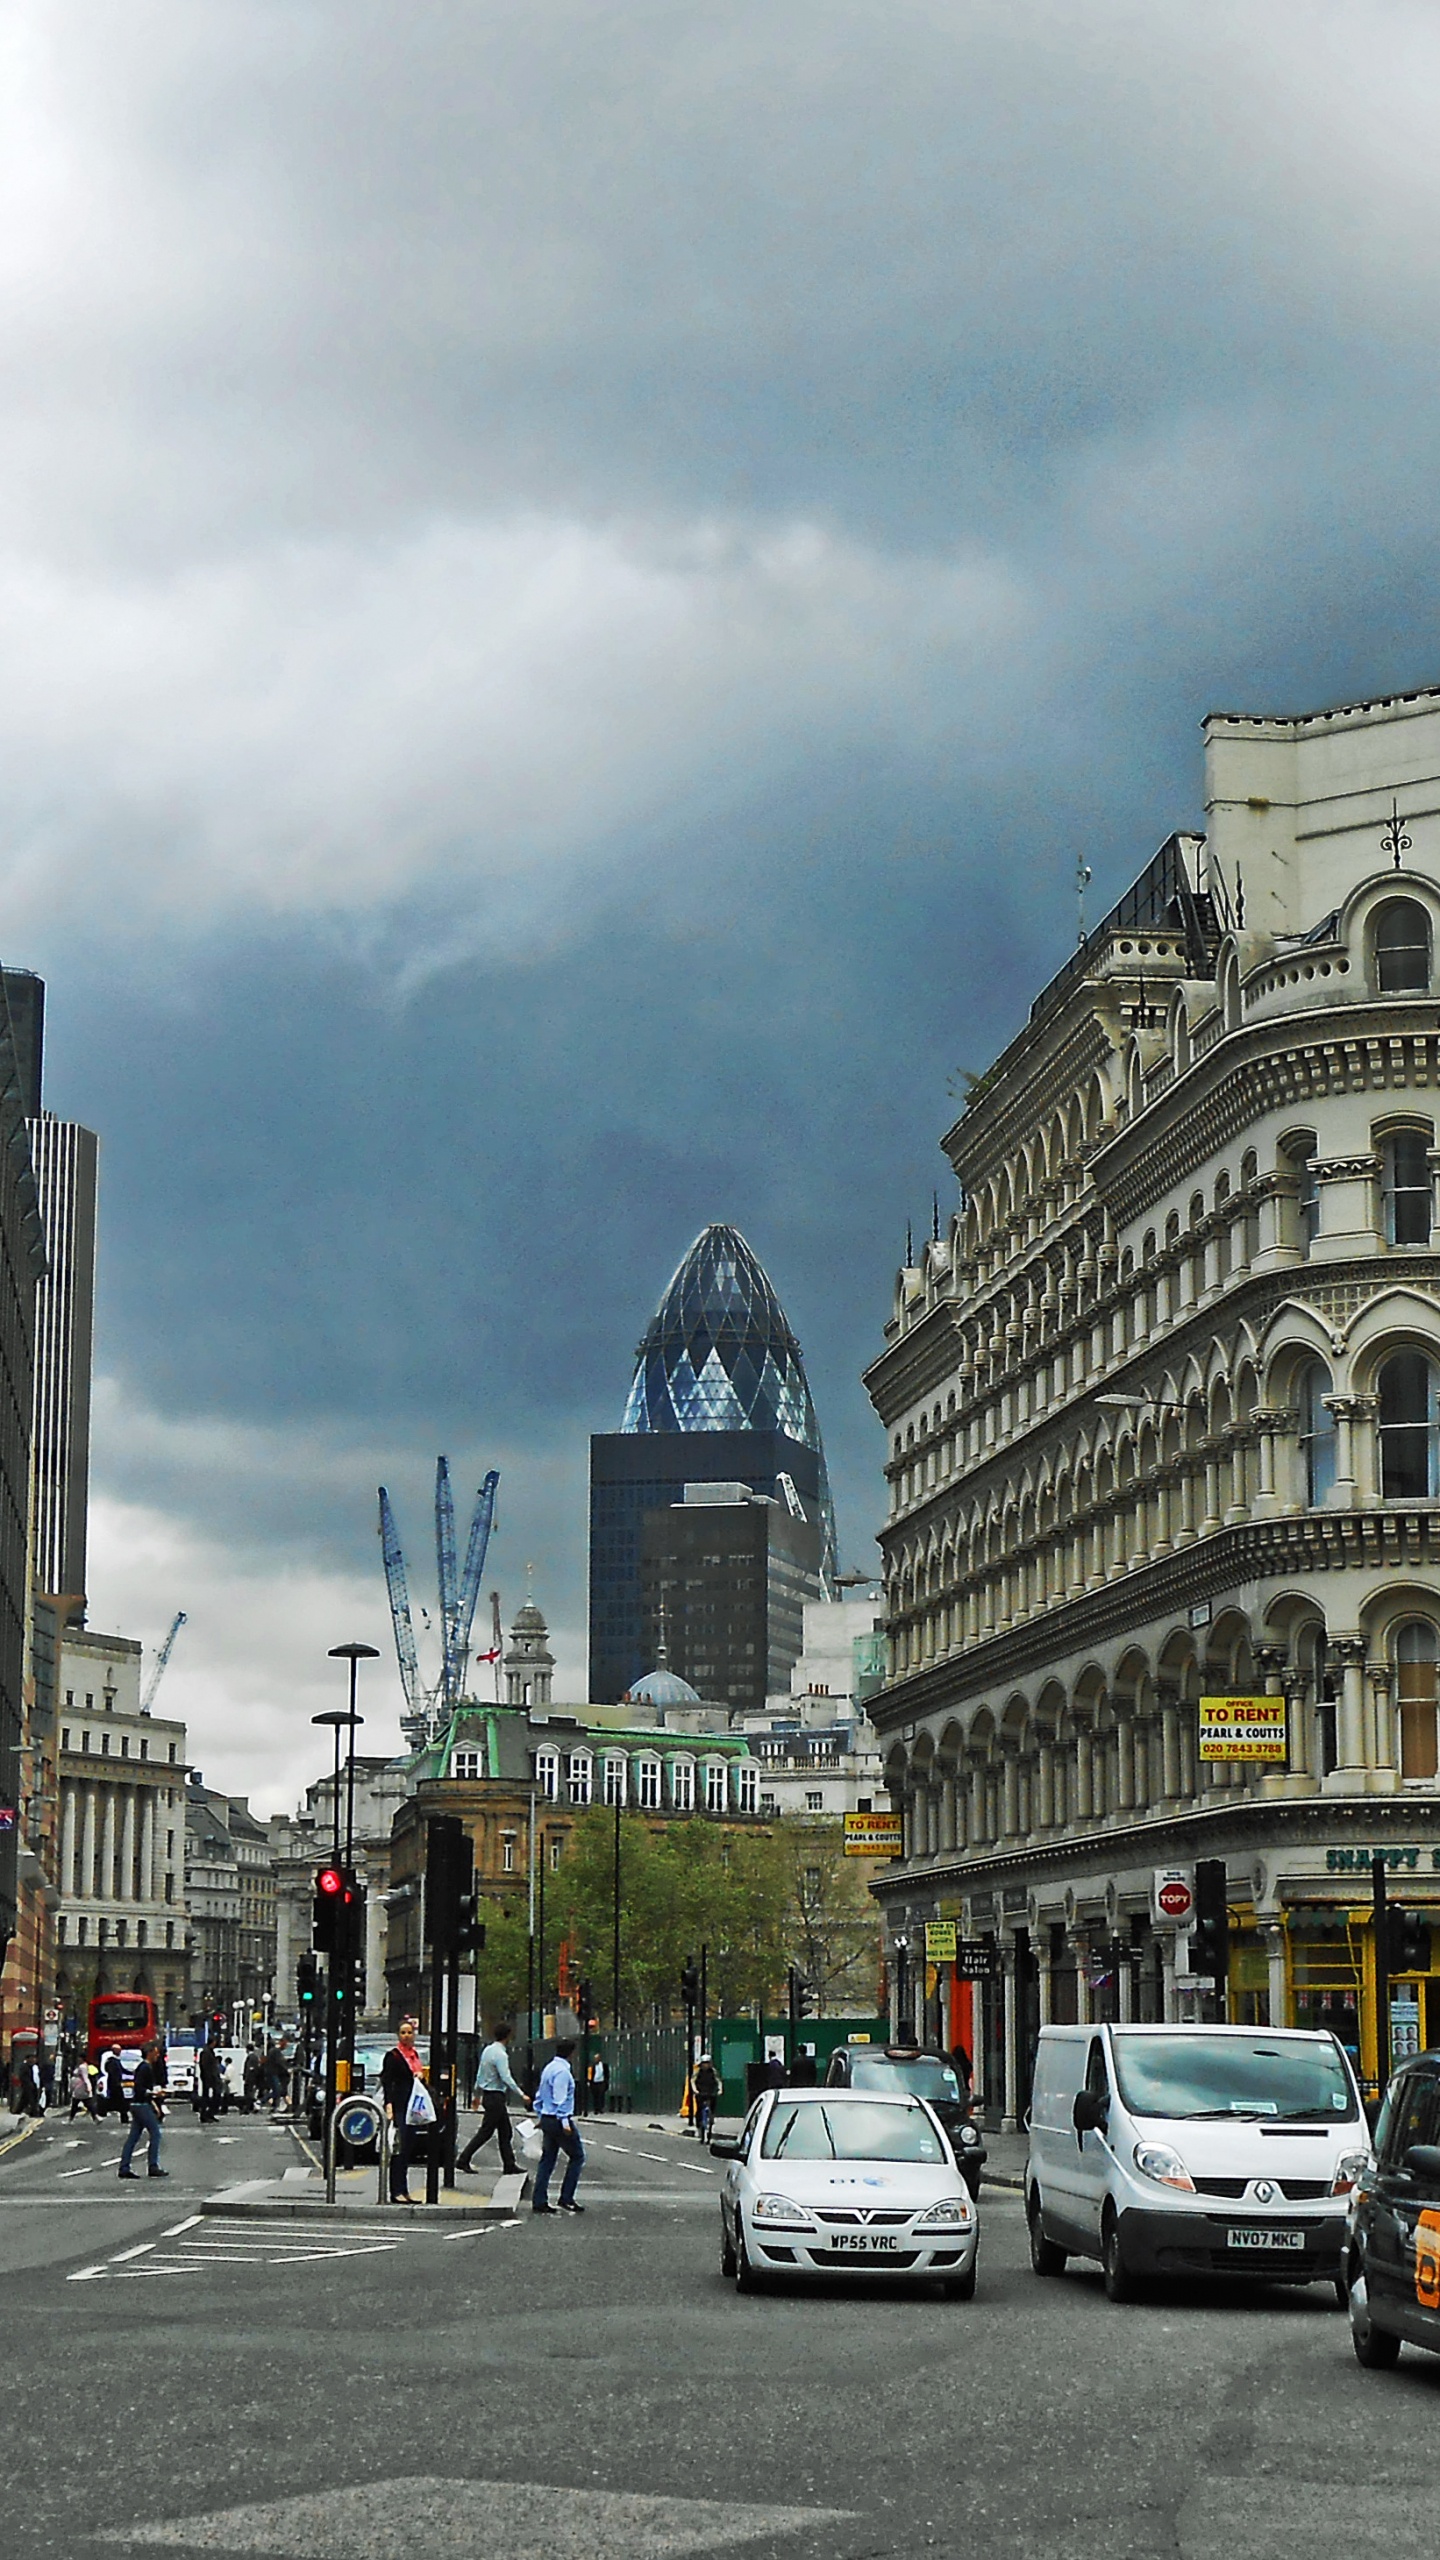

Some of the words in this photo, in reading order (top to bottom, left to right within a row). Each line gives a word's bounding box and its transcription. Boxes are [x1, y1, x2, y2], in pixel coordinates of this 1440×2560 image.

[1205, 1708, 1229, 1721] TO
[1234, 1708, 1280, 1721] RENT
[1200, 1728, 1232, 1738] PEARL
[1235, 1728, 1243, 1738] &
[1246, 1728, 1284, 1738] COUTTS
[1203, 1744, 1223, 1752] 020
[1226, 1744, 1252, 1752] 7843
[1255, 1744, 1281, 1752] 3788
[849, 1821, 864, 1829] TO
[867, 1821, 898, 1829] RENT
[1326, 1848, 1420, 1870] SNAPPY
[1161, 1895, 1188, 1903] TOPY
[965, 1956, 987, 1964] Hair
[962, 1965, 990, 1974] Salon
[831, 2235, 867, 2249] WP55
[871, 2236, 897, 2249] VRC
[1232, 2231, 1268, 2245] NV07
[1271, 2233, 1298, 2246] MKC
